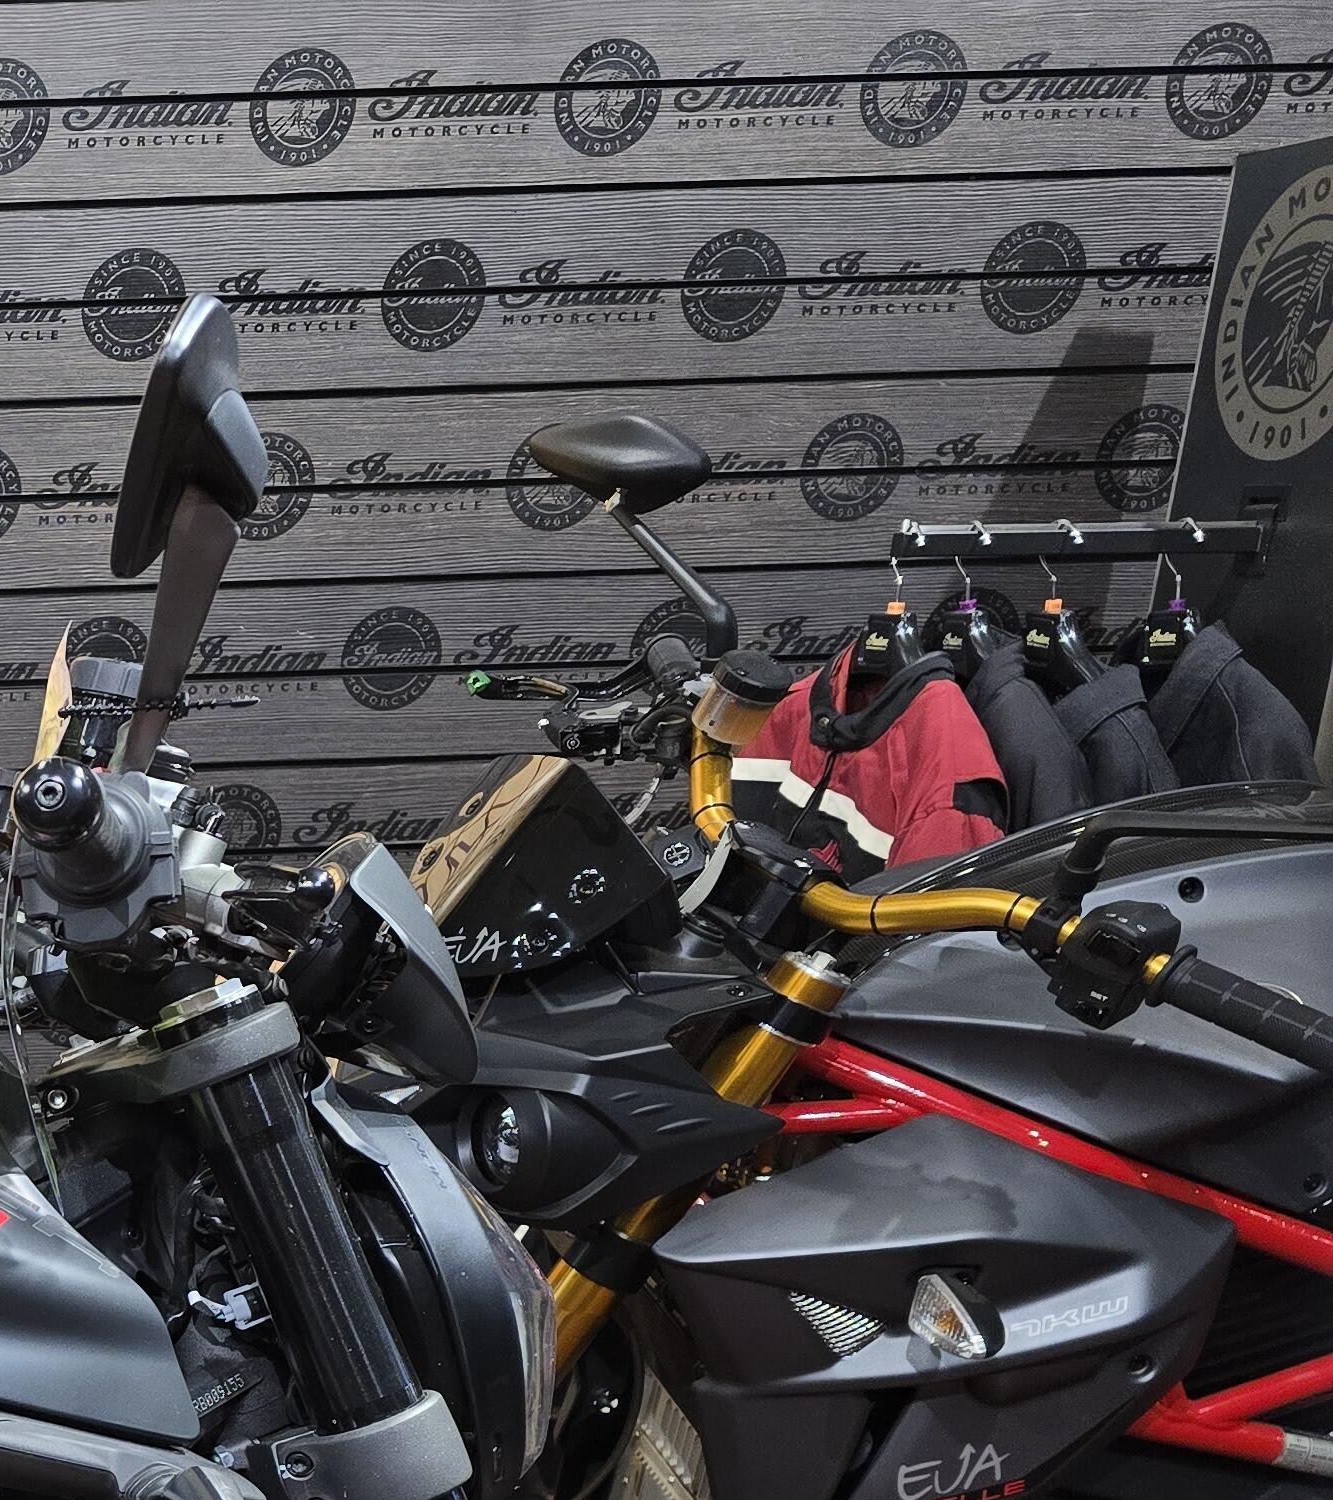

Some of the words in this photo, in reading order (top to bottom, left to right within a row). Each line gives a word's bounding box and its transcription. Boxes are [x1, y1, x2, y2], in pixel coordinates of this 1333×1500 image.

[673, 60, 841, 112] Indian
[979, 52, 1149, 104] Indian
[62, 79, 230, 132] Indian
[367, 69, 536, 121] Indian
[678, 115, 835, 129] MOTORCYCLE
[983, 107, 1138, 121] MOTORCYCLE
[1192, 121, 1229, 136] 1901
[68, 133, 225, 149] MOTORCYCLE
[373, 123, 531, 139] MOTORCYCLE
[584, 141, 621, 153] 1901
[888, 131, 925, 143] 1901
[281, 149, 317, 161] 1901
[696, 232, 743, 265] SINCE
[996, 226, 1043, 258] SINCE
[95, 253, 140, 286] SINCE
[394, 244, 442, 276] SINCE
[799, 251, 963, 299] Indian
[219, 269, 365, 316] Indian
[499, 260, 664, 307] Indian
[503, 311, 657, 325] MOTORCYCLE
[802, 303, 956, 316] MOTORCYCLE
[987, 290, 1074, 329] MOTORCYCLE
[1101, 297, 1209, 307] MOTORCY
[1223, 224, 1275, 401] INDIAN
[239, 320, 359, 333] TORCYCLE
[388, 308, 476, 347] MOTORCYCLE
[687, 299, 775, 338] MOTORCYCLE
[88, 321, 166, 356] MOTORCYC
[1249, 417, 1308, 450] 1901
[710, 452, 787, 485] dian
[916, 433, 1079, 480] Indian
[329, 452, 491, 498] Indian
[919, 484, 1070, 495] MOTORCYCLE
[332, 501, 484, 515] MOTORCYCLE
[691, 491, 777, 504] RCYCLE
[828, 505, 865, 517] 1901
[38, 514, 114, 525] MOTOR
[242, 525, 278, 537] 1901
[534, 515, 570, 527] 1901
[190, 636, 326, 673] Indian
[454, 624, 616, 665] Indian
[188, 682, 319, 696] OTORCYCLE
[293, 802, 444, 844] Indian
